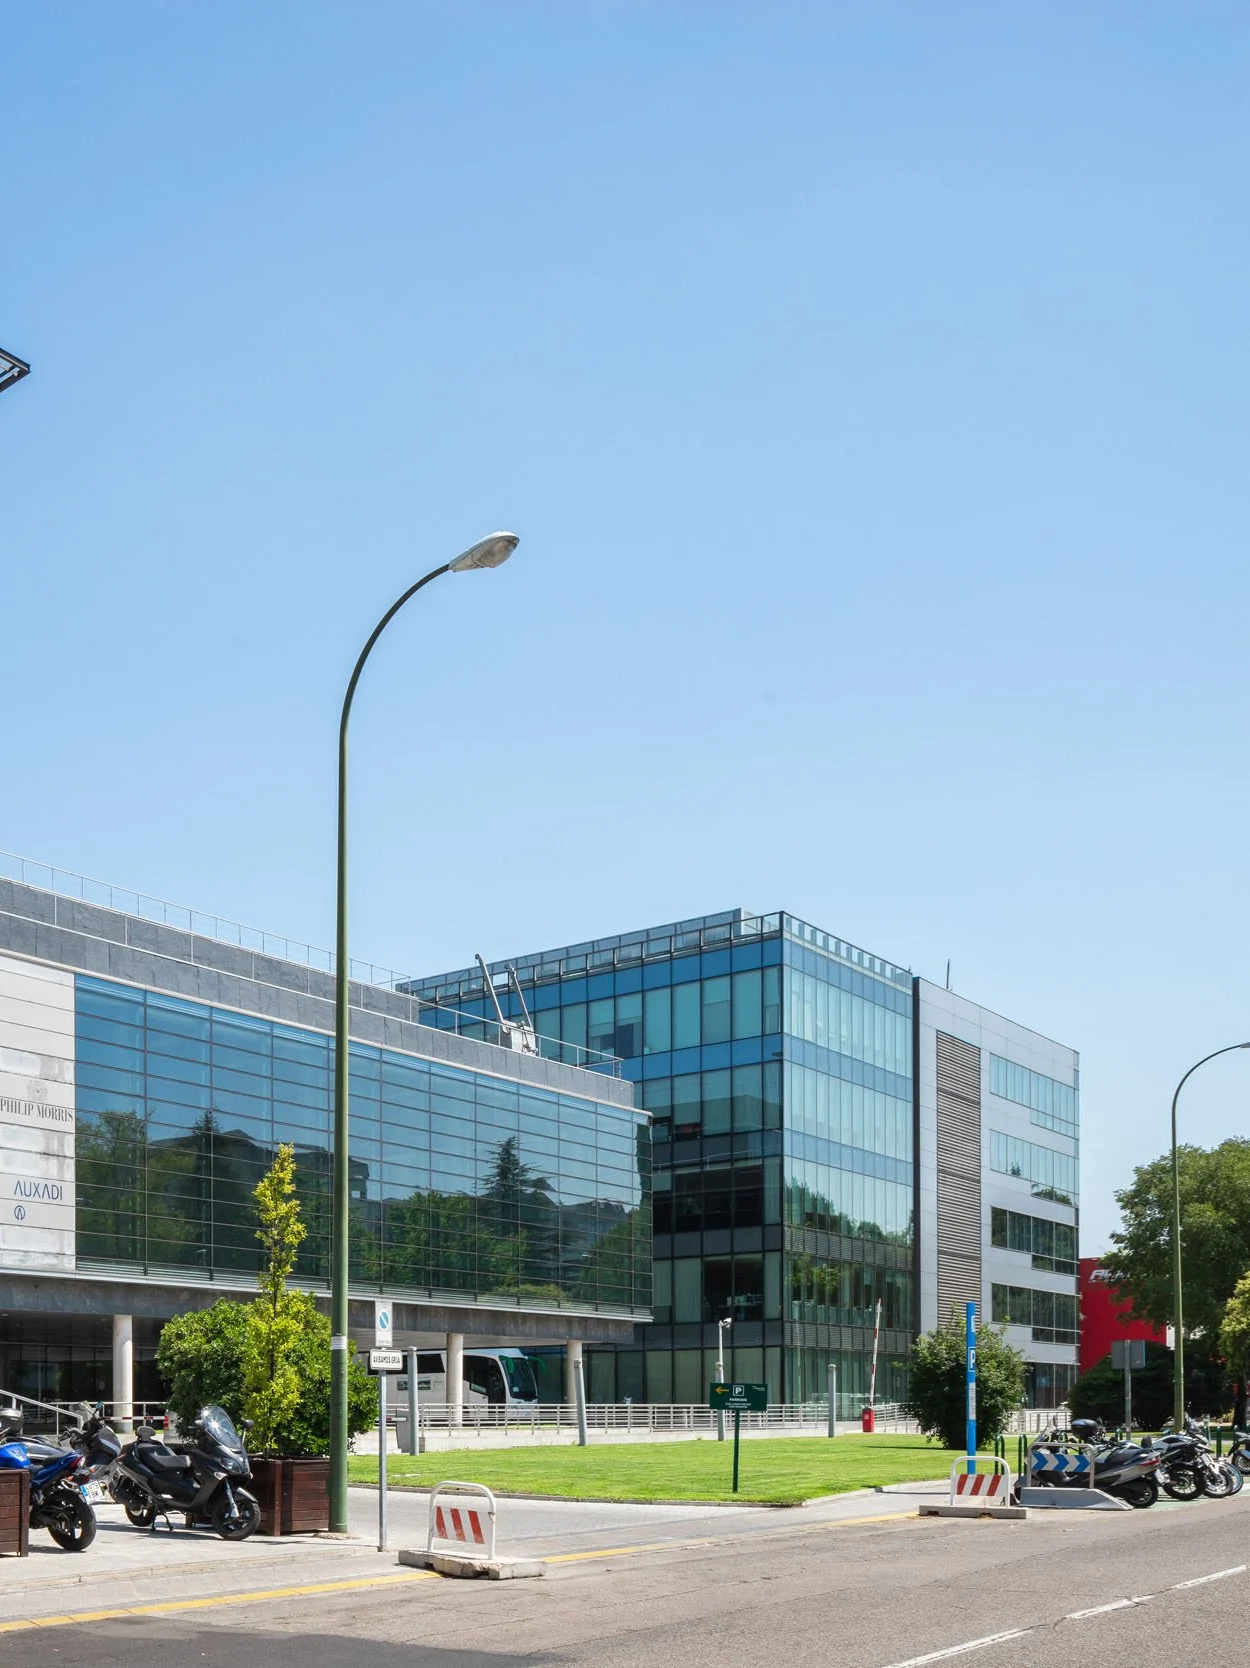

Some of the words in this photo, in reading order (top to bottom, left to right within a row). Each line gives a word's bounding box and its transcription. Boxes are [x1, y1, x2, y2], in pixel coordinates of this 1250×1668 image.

[0, 1098, 34, 1117] PHILIP
[36, 1105, 73, 1123] MORRIS
[14, 1180, 62, 1201] AUXADI
